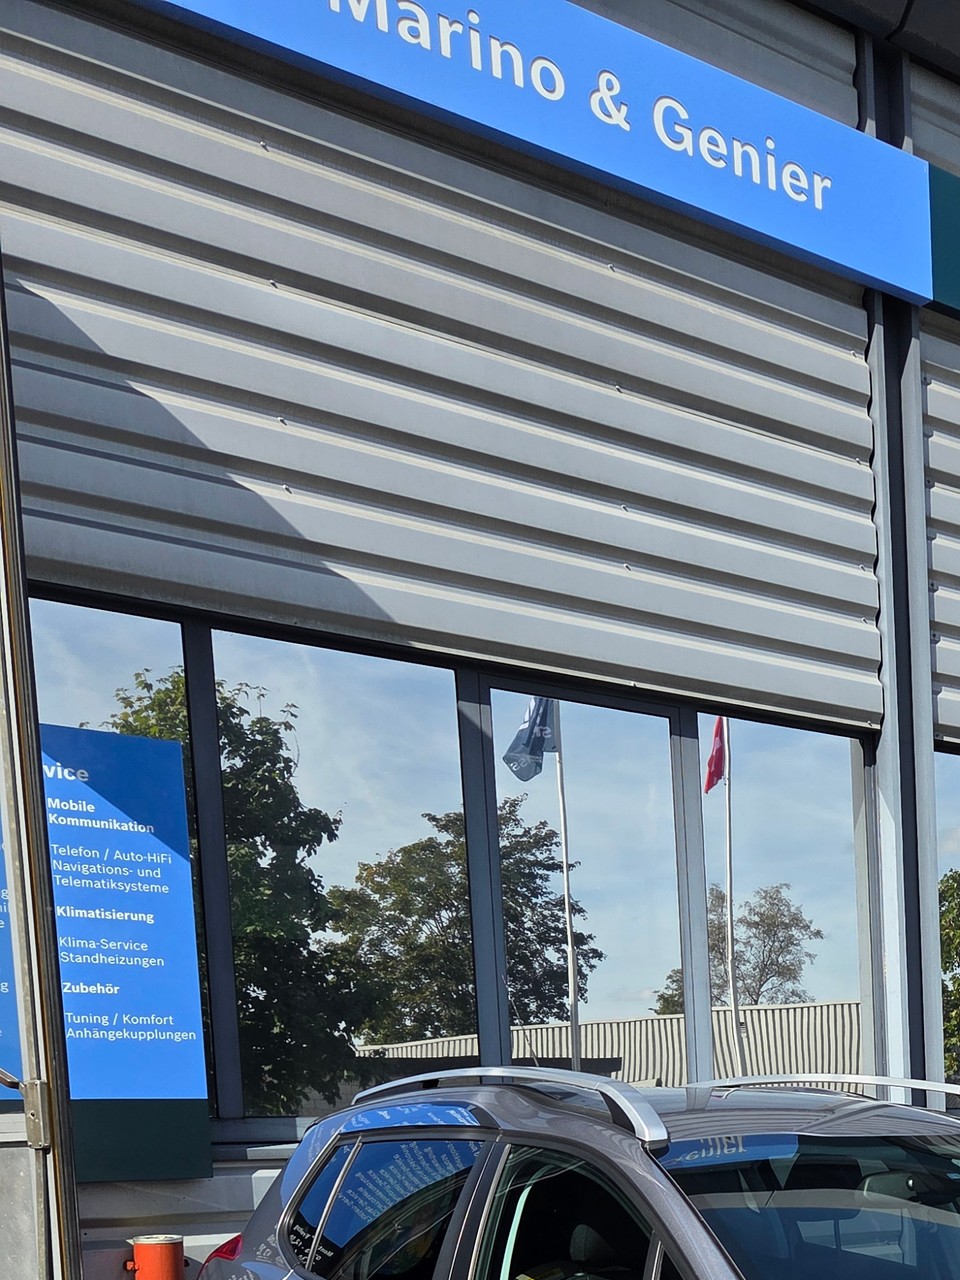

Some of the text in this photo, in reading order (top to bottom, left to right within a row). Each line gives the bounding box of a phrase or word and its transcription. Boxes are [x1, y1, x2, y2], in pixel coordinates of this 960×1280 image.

[589, 70, 632, 131] &
[652, 95, 833, 210] Genier
[47, 797, 96, 814] Mobile
[48, 813, 154, 834] Kommunikation
[51, 843, 172, 865] Telefon / Auto-HiFi
[52, 859, 161, 879] Navigations- und
[53, 875, 170, 894] Telematiksysteme
[56, 905, 155, 925] Klimatisierung
[59, 936, 148, 952] Klima-Service
[60, 951, 165, 968] Standheizungen
[62, 981, 120, 995] Zubehör
[65, 1012, 174, 1027] Tuning / Komfort
[66, 1028, 197, 1042] Anhängekupplungen
